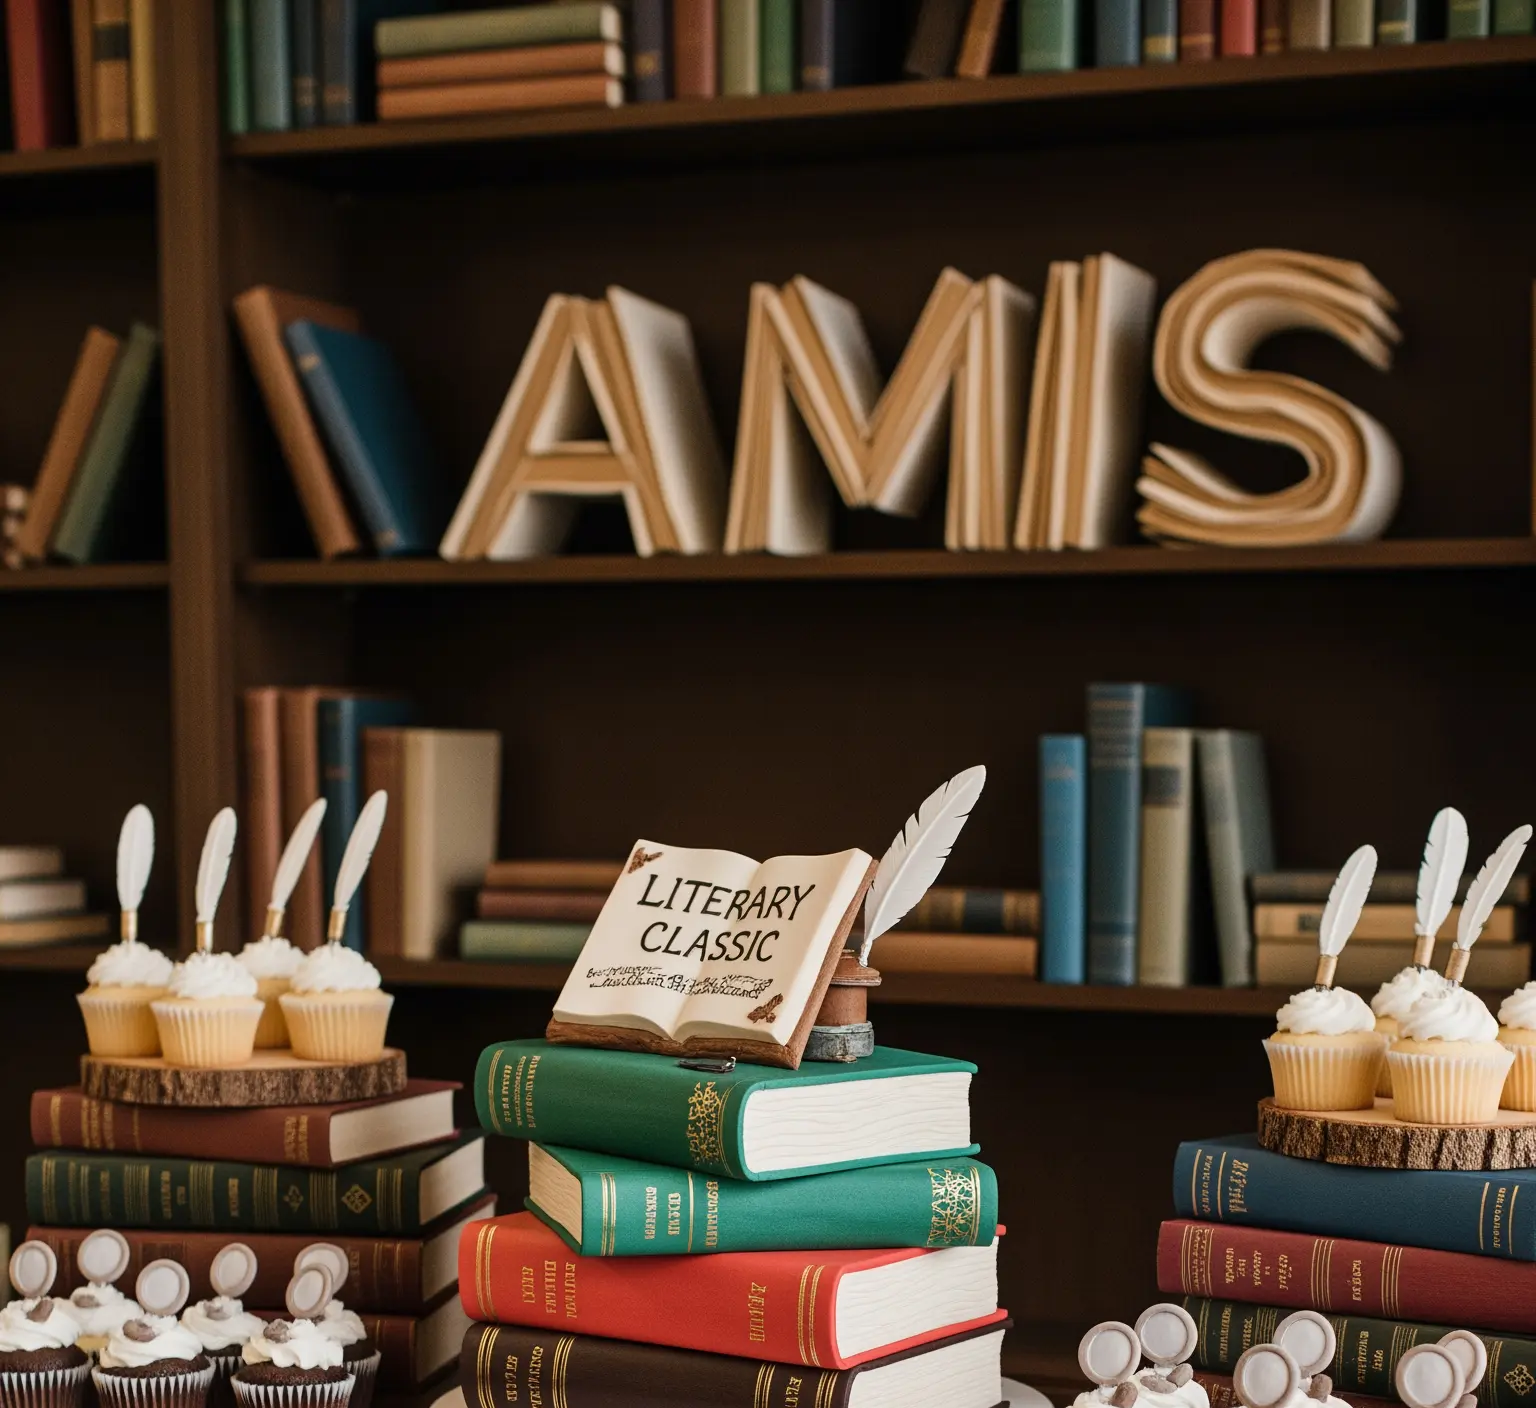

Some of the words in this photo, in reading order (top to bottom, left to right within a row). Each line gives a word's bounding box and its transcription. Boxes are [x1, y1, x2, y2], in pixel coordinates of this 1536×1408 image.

[438, 247, 1402, 561] AMIS
[637, 874, 816, 921] LITERARY
[640, 921, 779, 962] CLASSIC
